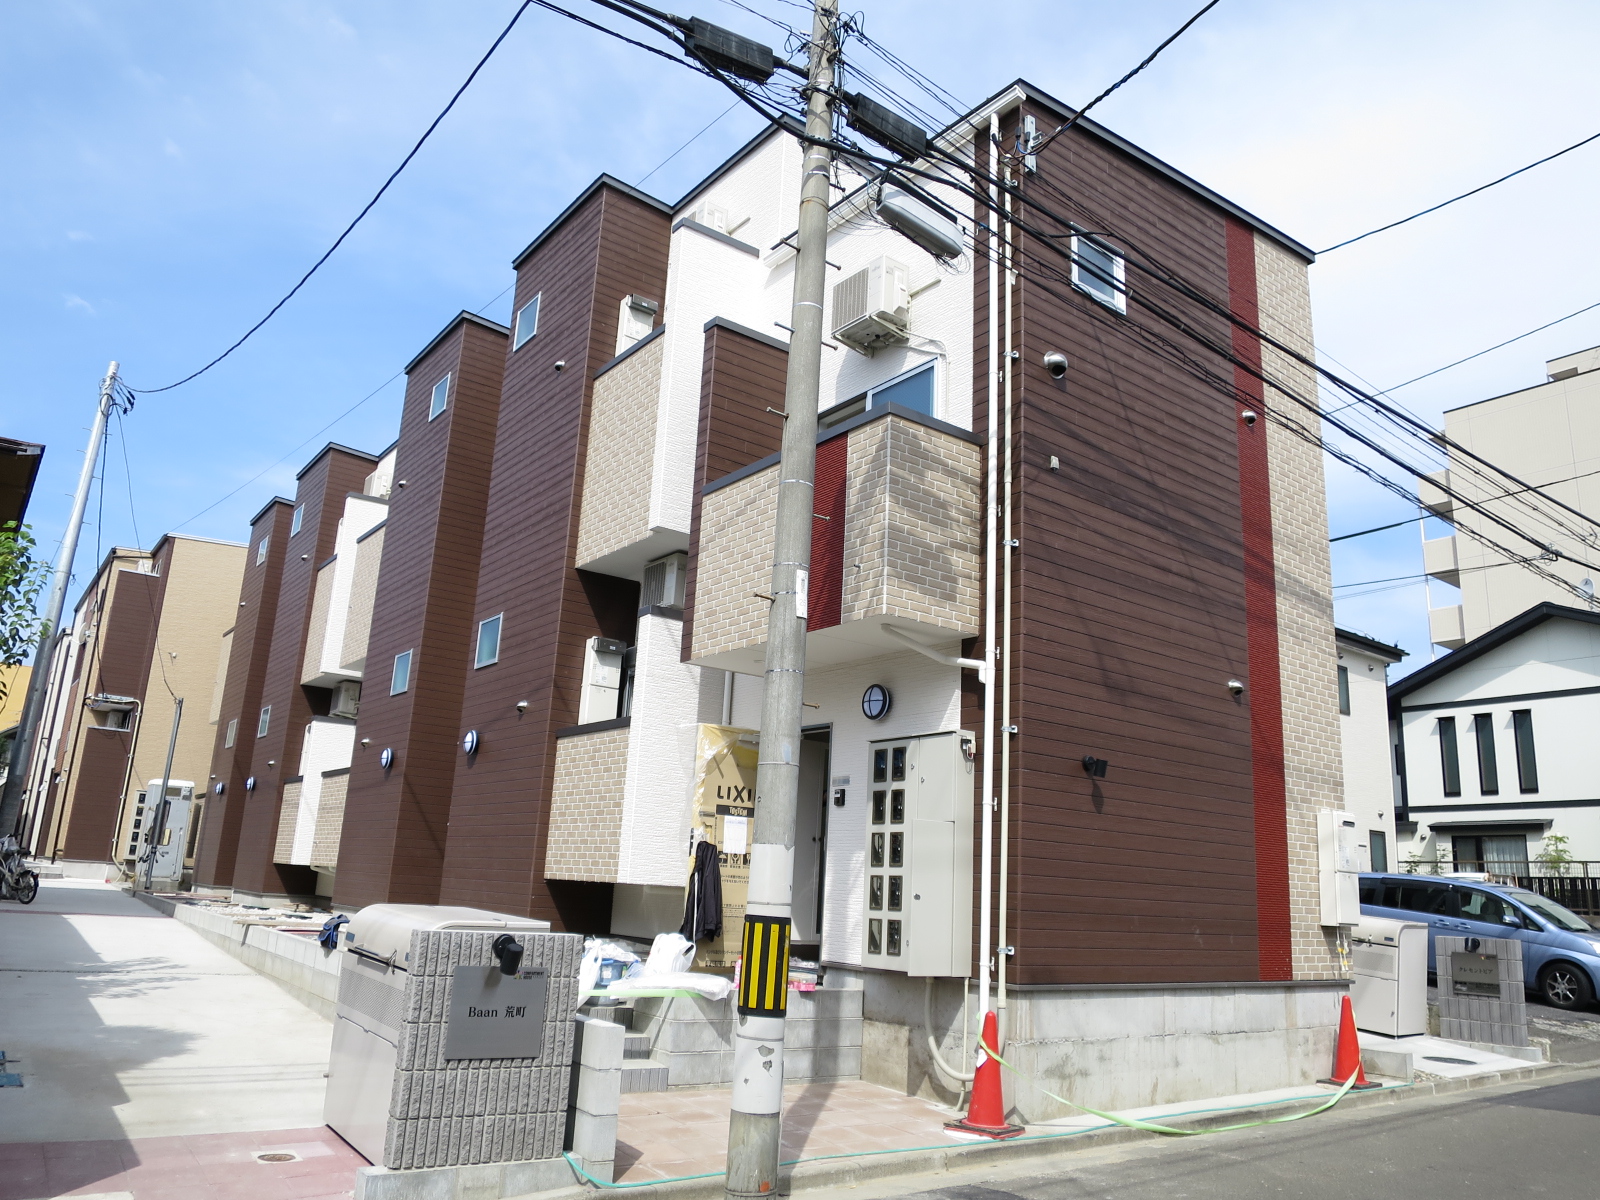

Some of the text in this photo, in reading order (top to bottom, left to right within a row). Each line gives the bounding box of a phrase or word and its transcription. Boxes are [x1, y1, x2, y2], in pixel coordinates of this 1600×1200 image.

[717, 785, 756, 804] LIXI
[468, 1005, 526, 1018] Baan 荒町
